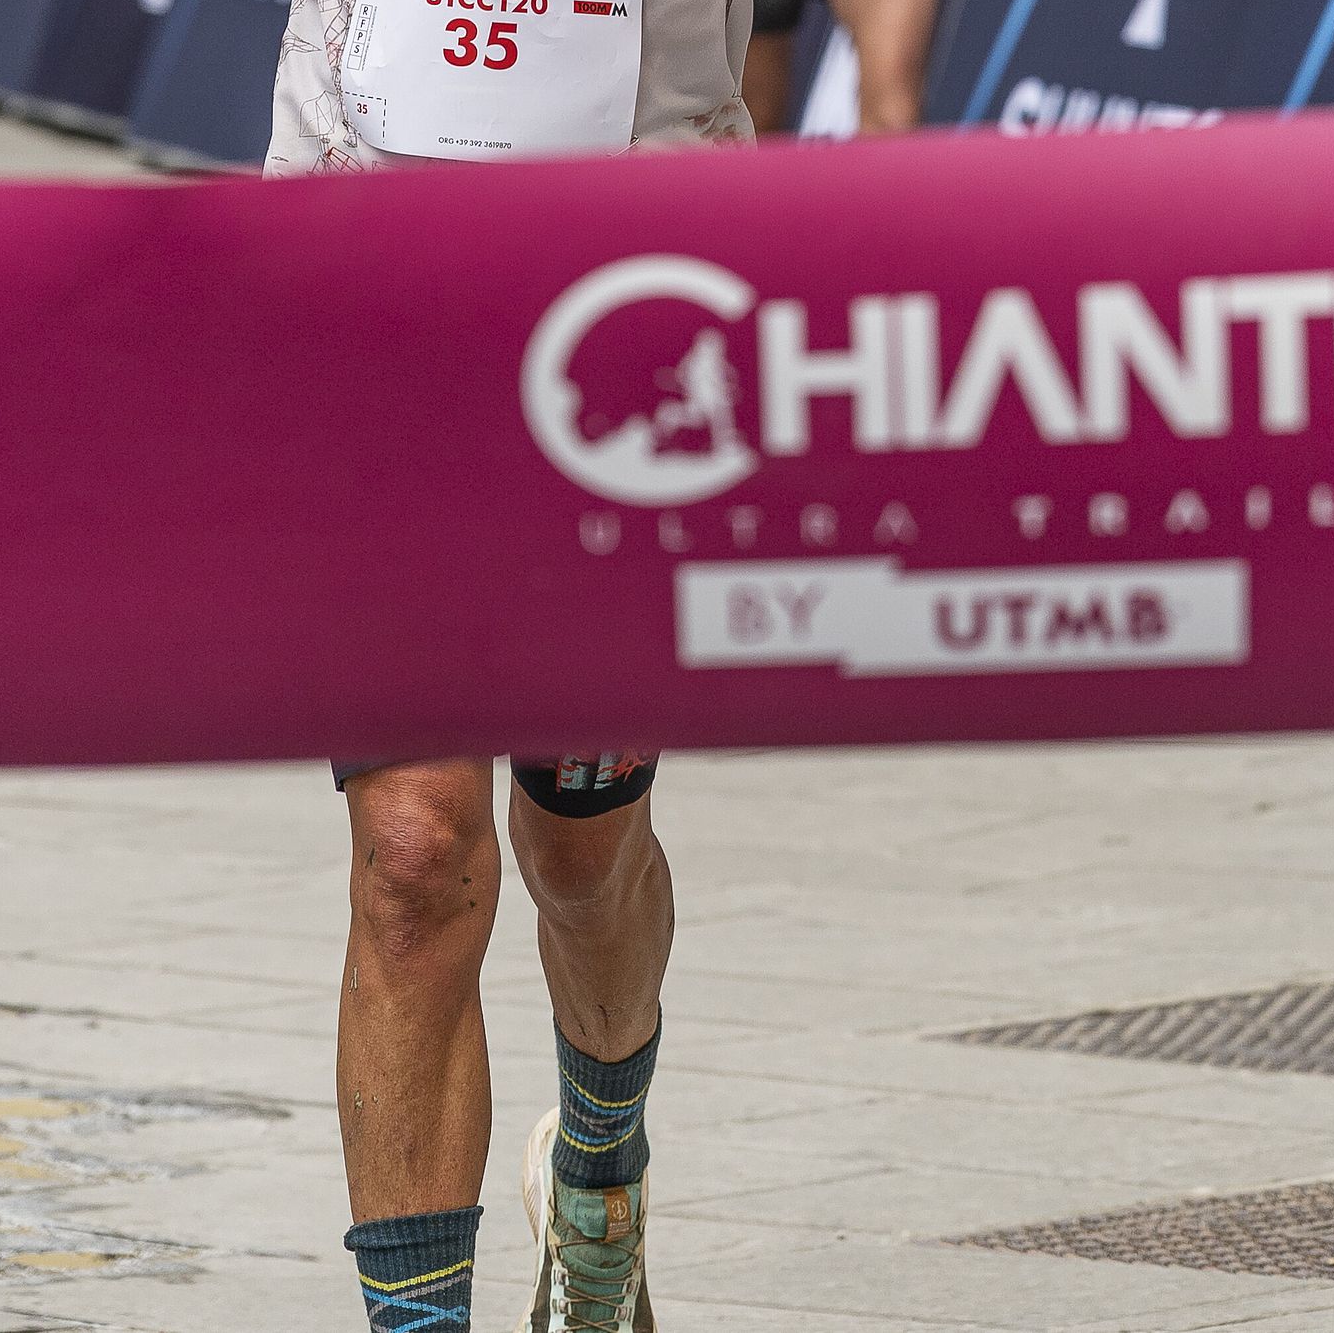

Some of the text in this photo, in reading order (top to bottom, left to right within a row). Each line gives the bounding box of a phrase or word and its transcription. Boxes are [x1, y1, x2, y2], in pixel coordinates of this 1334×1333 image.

[443, 18, 518, 70] 35
[356, 103, 368, 114] 35
[578, 500, 917, 556] ULTRA
[725, 580, 1170, 651] BY UTMB
